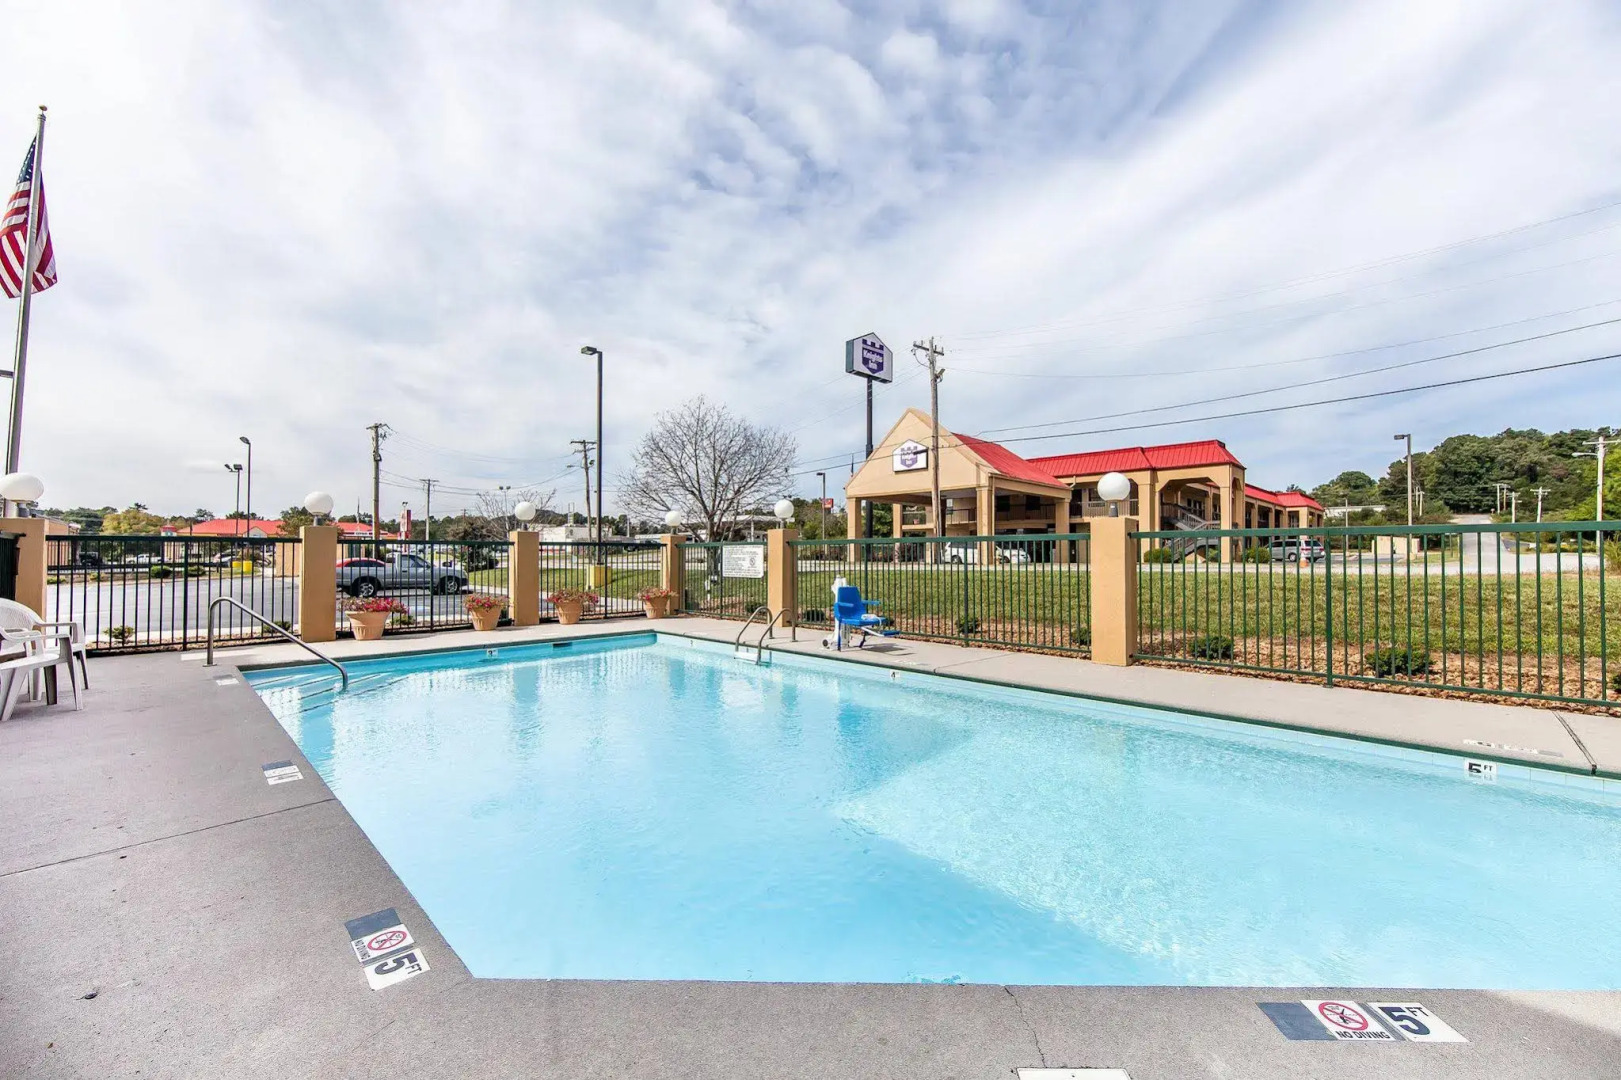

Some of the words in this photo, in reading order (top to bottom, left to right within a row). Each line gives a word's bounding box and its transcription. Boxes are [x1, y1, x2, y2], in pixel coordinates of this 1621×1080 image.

[1468, 762, 1482, 773] 5
[1483, 764, 1494, 772] FT
[374, 952, 418, 975] 5
[404, 963, 422, 974] FT
[1404, 1006, 1429, 1017] FT
[1378, 1006, 1431, 1036] 5
[1335, 1030, 1352, 1039] NO
[1353, 1030, 1391, 1039] DIVING
